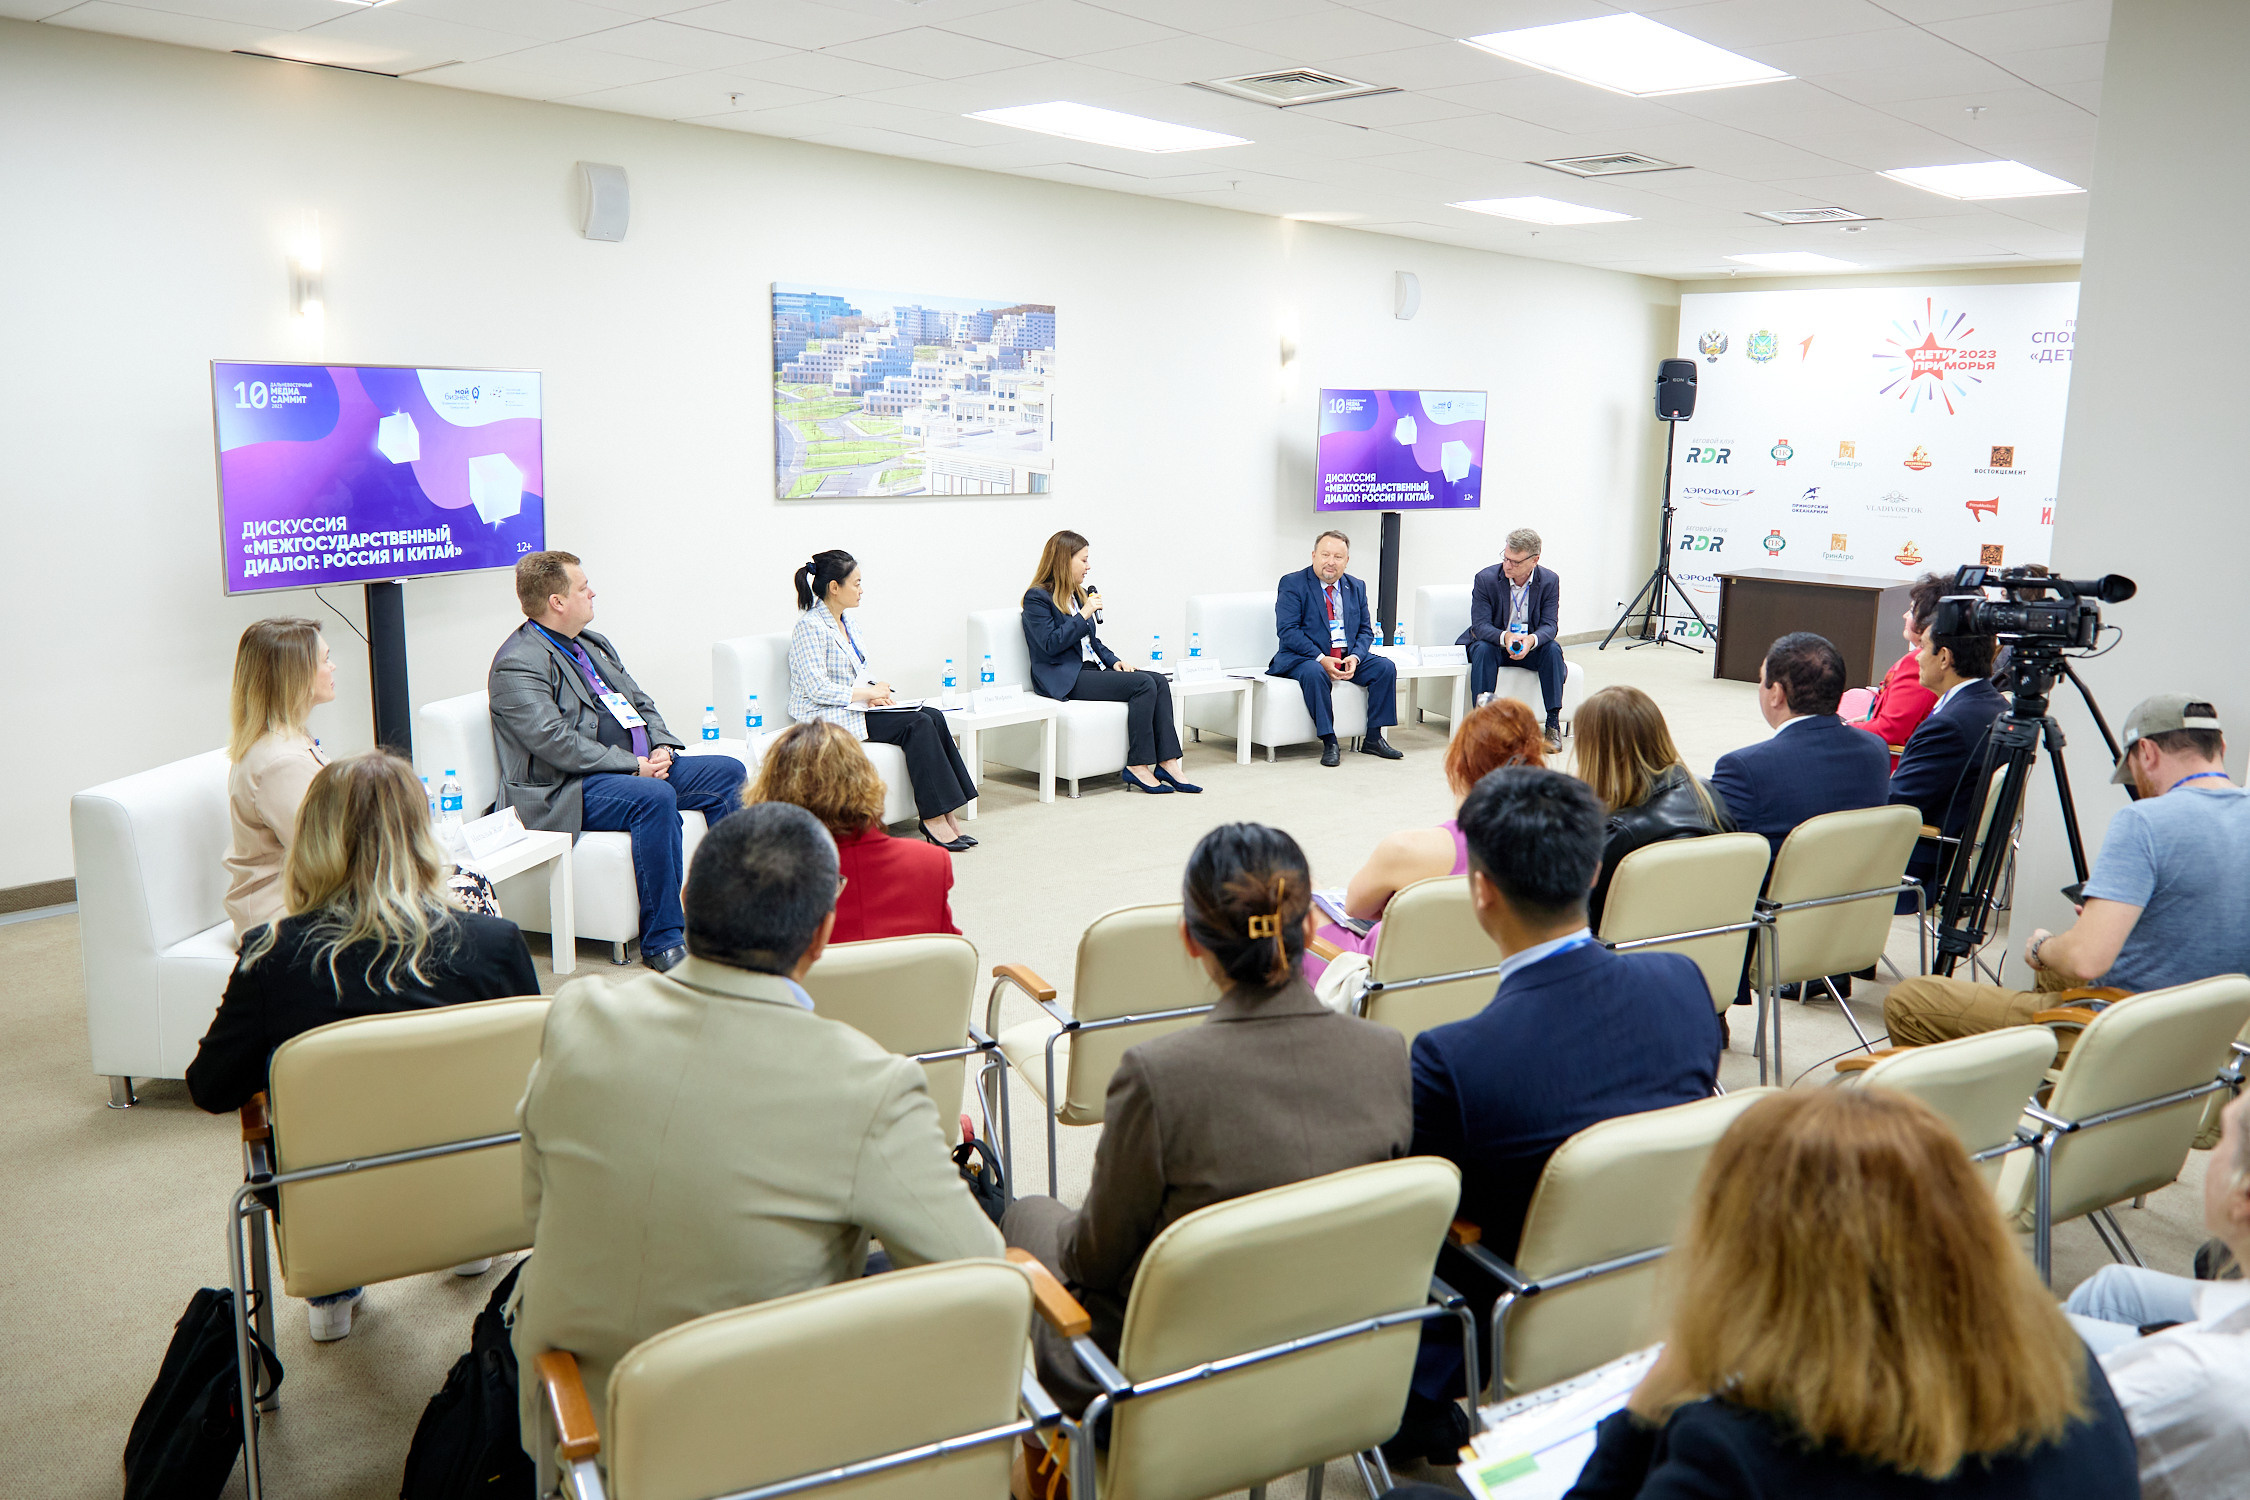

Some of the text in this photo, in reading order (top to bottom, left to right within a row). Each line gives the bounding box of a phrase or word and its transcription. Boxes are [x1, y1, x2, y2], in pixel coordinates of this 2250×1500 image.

[1913, 349, 1997, 361] ДЕТИ 2023
[1914, 361, 1995, 371] ПРИМОРЬЯ
[233, 380, 268, 409] 10
[270, 387, 300, 395] МЕДИА
[270, 395, 307, 403] САММИТ
[1328, 398, 1346, 414] 10
[1686, 447, 1732, 464] RDR
[1831, 460, 1863, 469] ГринАгро
[1325, 473, 1377, 483] ДИСКУССИЯ
[1974, 468, 2027, 476] ВОСТОКЦЕМЕНТ
[1325, 481, 1429, 493] «МЕЖГОСУДАРСТВЕННЫЙ
[1683, 487, 1741, 496] АЭРОФЛОТ
[1324, 491, 1435, 504] ДИАЛОГ: РОССИЯ И КИТАЙ»
[1865, 504, 1923, 514] VLADIVOSTOK
[241, 515, 347, 540] ДИСКУССИЯ
[243, 523, 451, 556] «МЕЖГОСУДАРСТВЕННЫЙ
[1680, 534, 1725, 552] RDR
[516, 541, 533, 553] 12+
[243, 541, 463, 578] ДИАЛОГ: РОССИЯ И КИТАЙ»
[1822, 551, 1854, 560] ГринАгро
[1677, 574, 1721, 582] АЭРОФЛ
